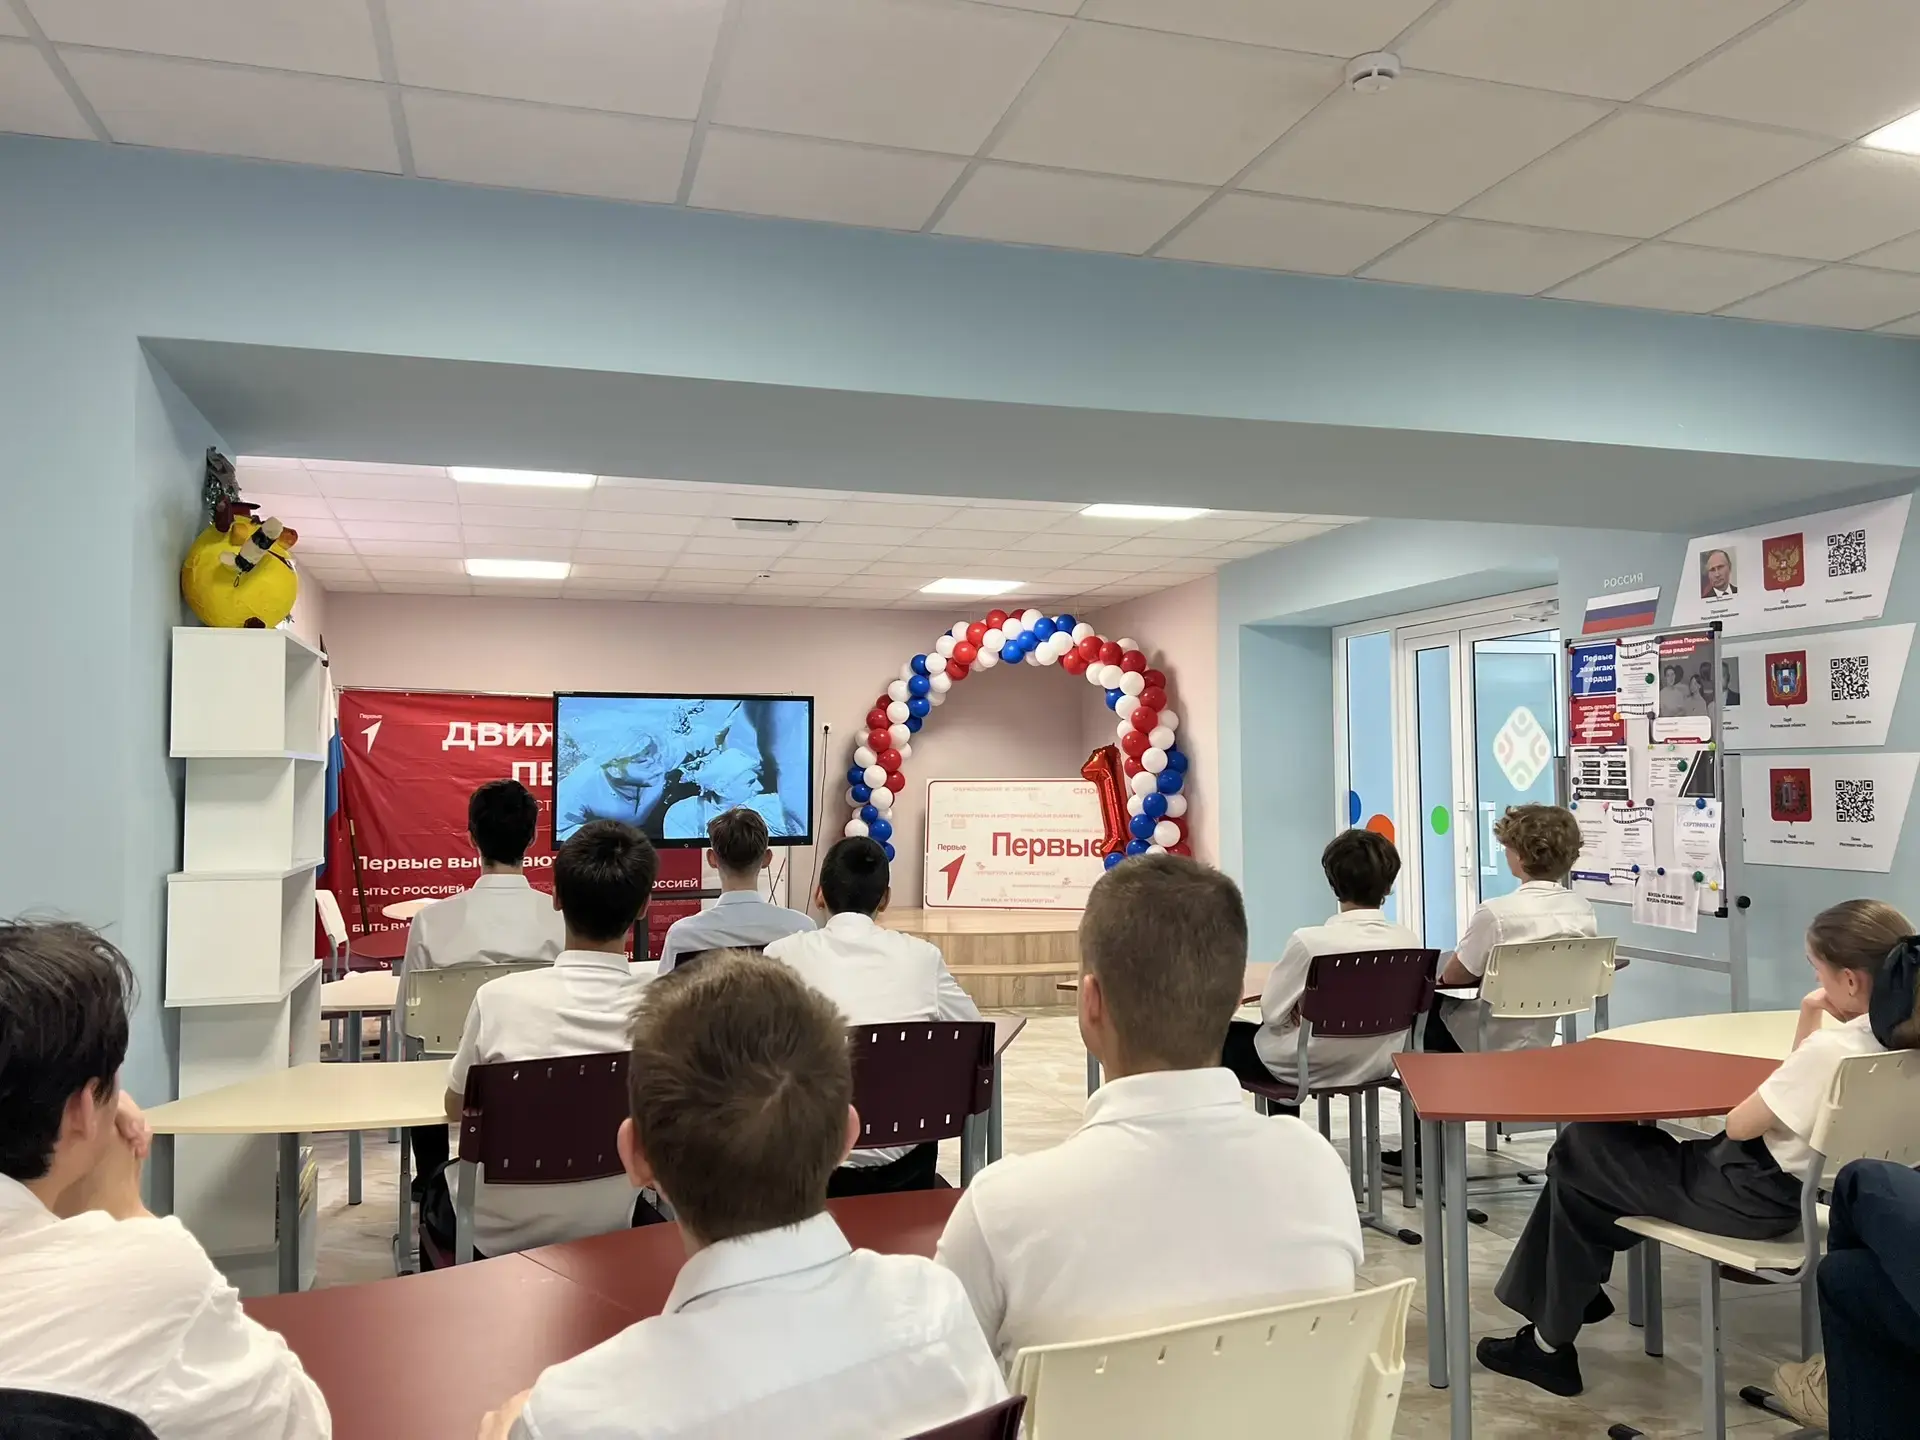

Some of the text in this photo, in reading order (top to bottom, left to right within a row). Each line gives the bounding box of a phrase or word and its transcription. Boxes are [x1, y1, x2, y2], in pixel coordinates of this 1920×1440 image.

[1603, 572, 1643, 588] РОССИЯ
[1583, 653, 1614, 662] Первые
[1584, 675, 1612, 684] сердца
[1073, 787, 1098, 795] СПО
[937, 843, 967, 852] Первые
[992, 831, 1103, 864] Первые
[402, 883, 465, 895] РОССИЕЙ
